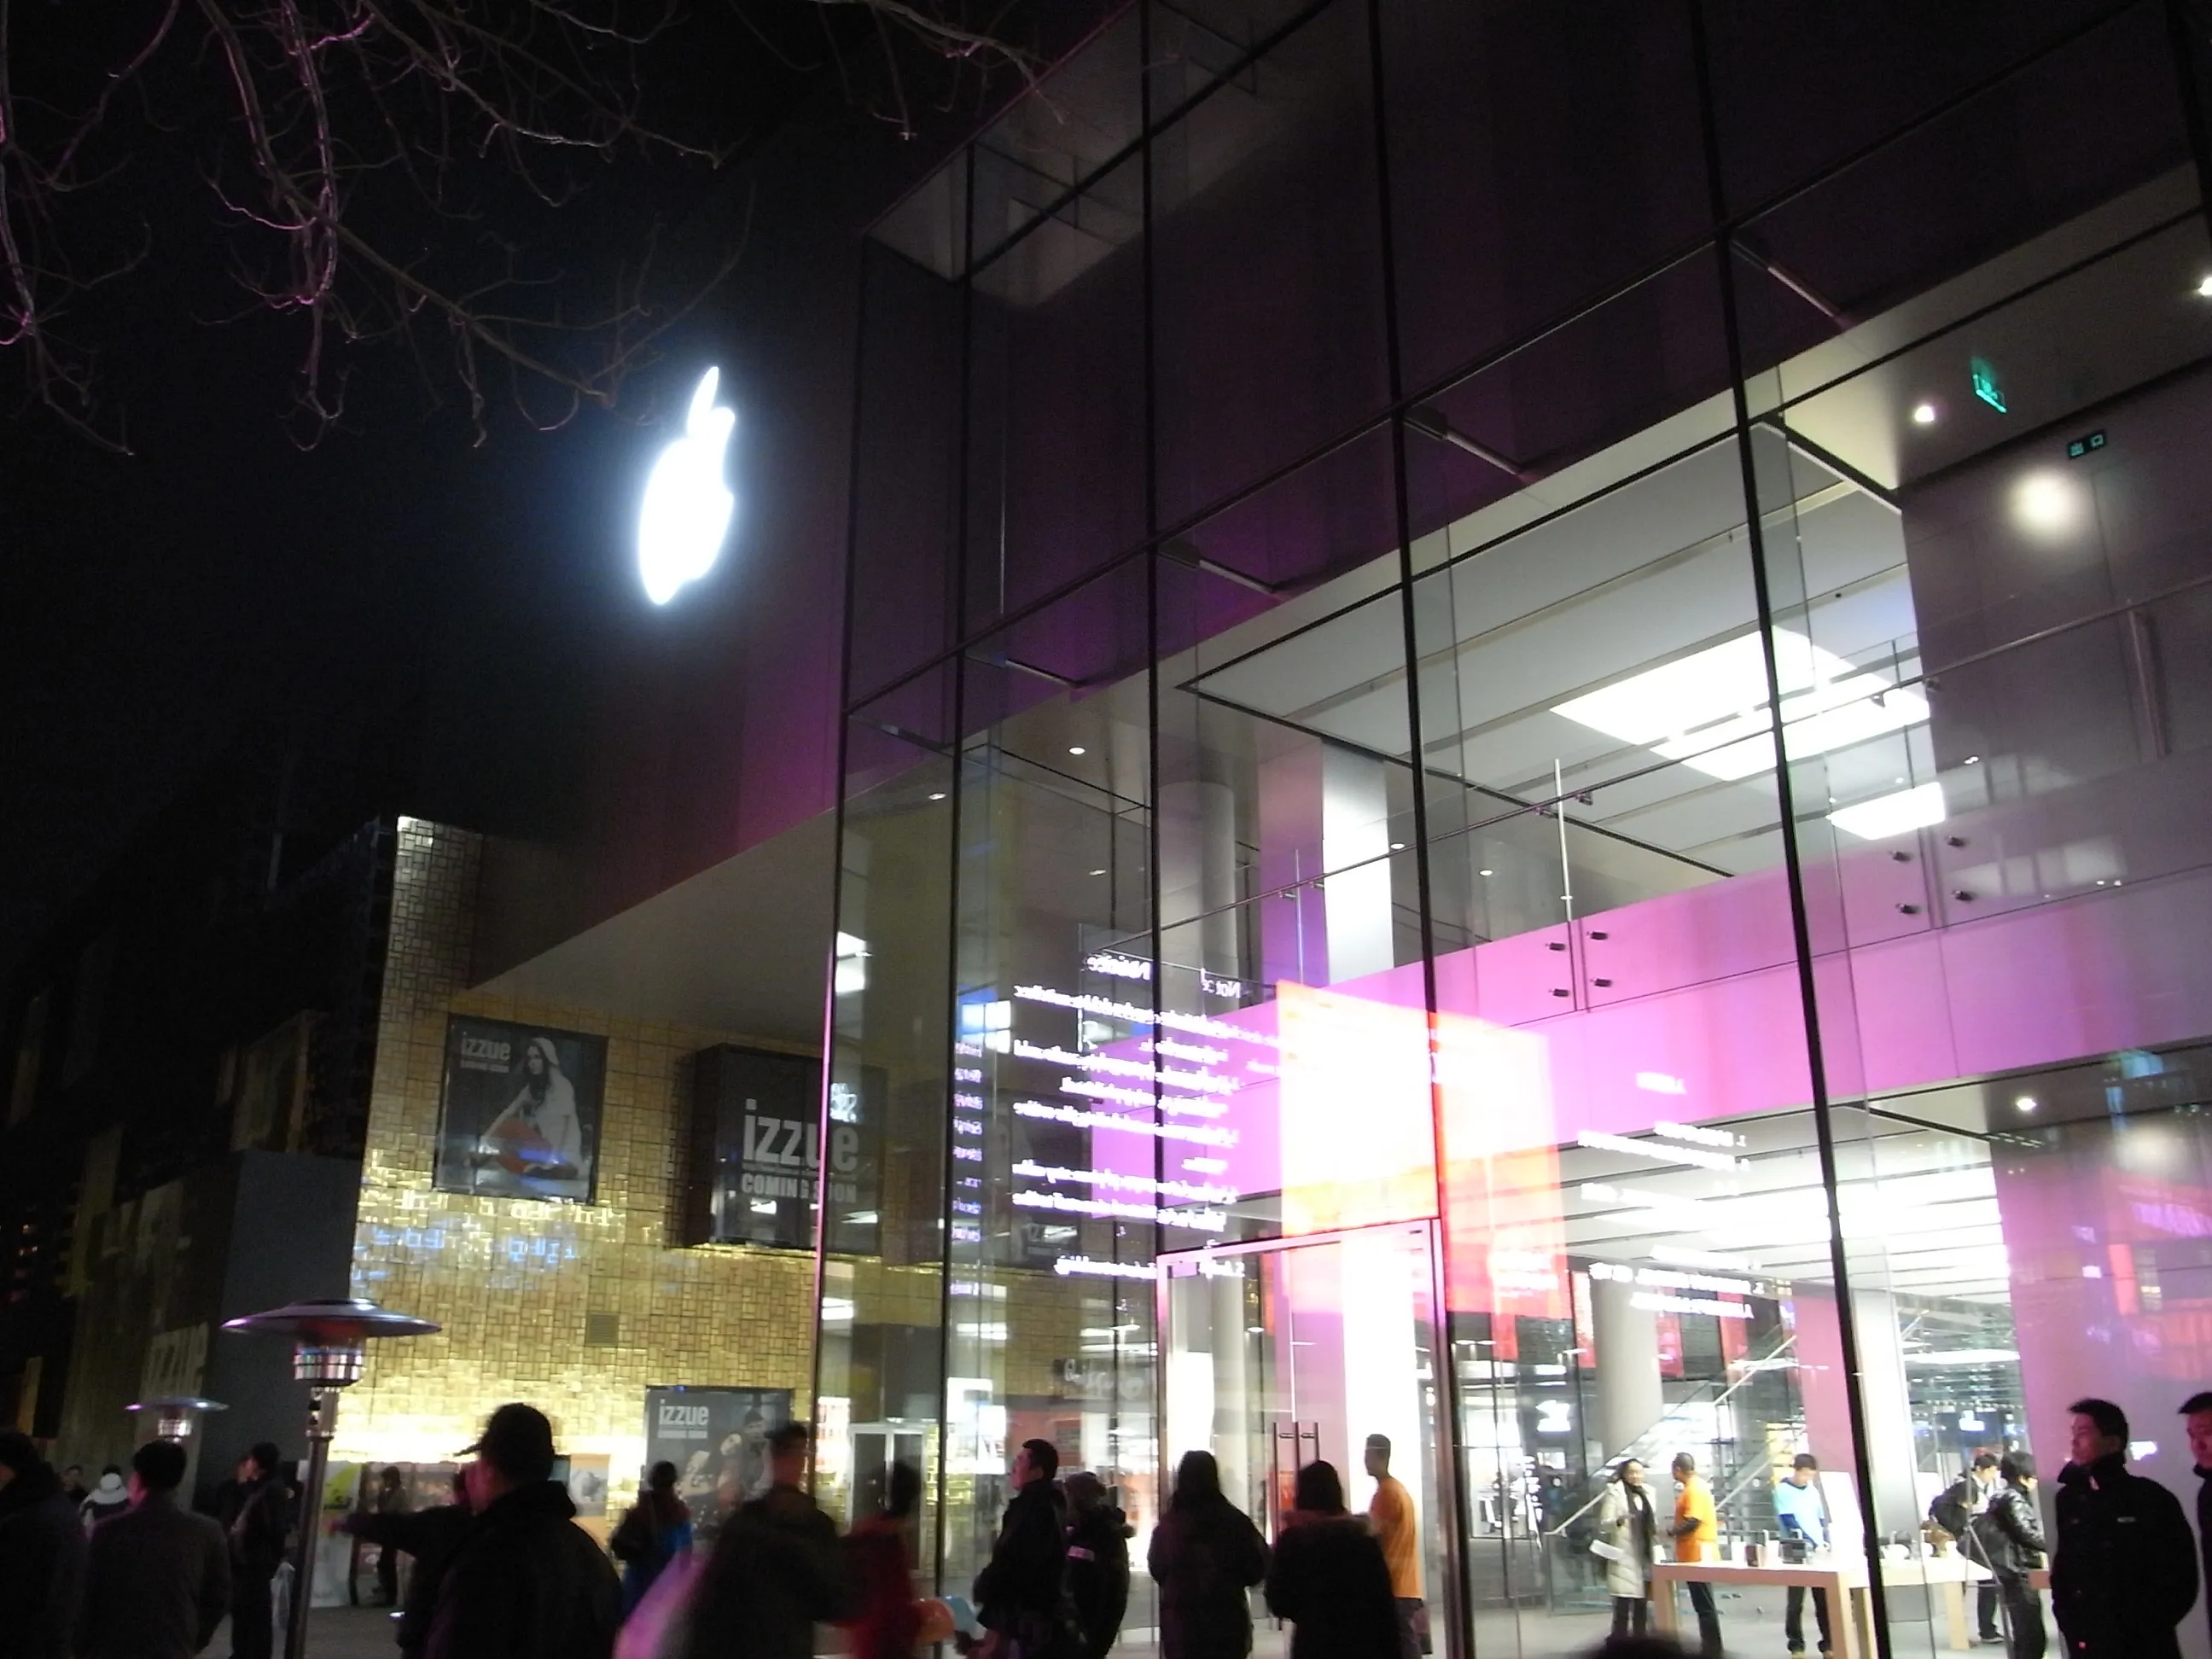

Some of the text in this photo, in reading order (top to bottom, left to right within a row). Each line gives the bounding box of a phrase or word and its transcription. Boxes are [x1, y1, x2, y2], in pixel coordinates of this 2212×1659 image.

[461, 1031, 511, 1061] izzue
[742, 1173, 810, 1200] COMING
[659, 1399, 709, 1425] izzue
